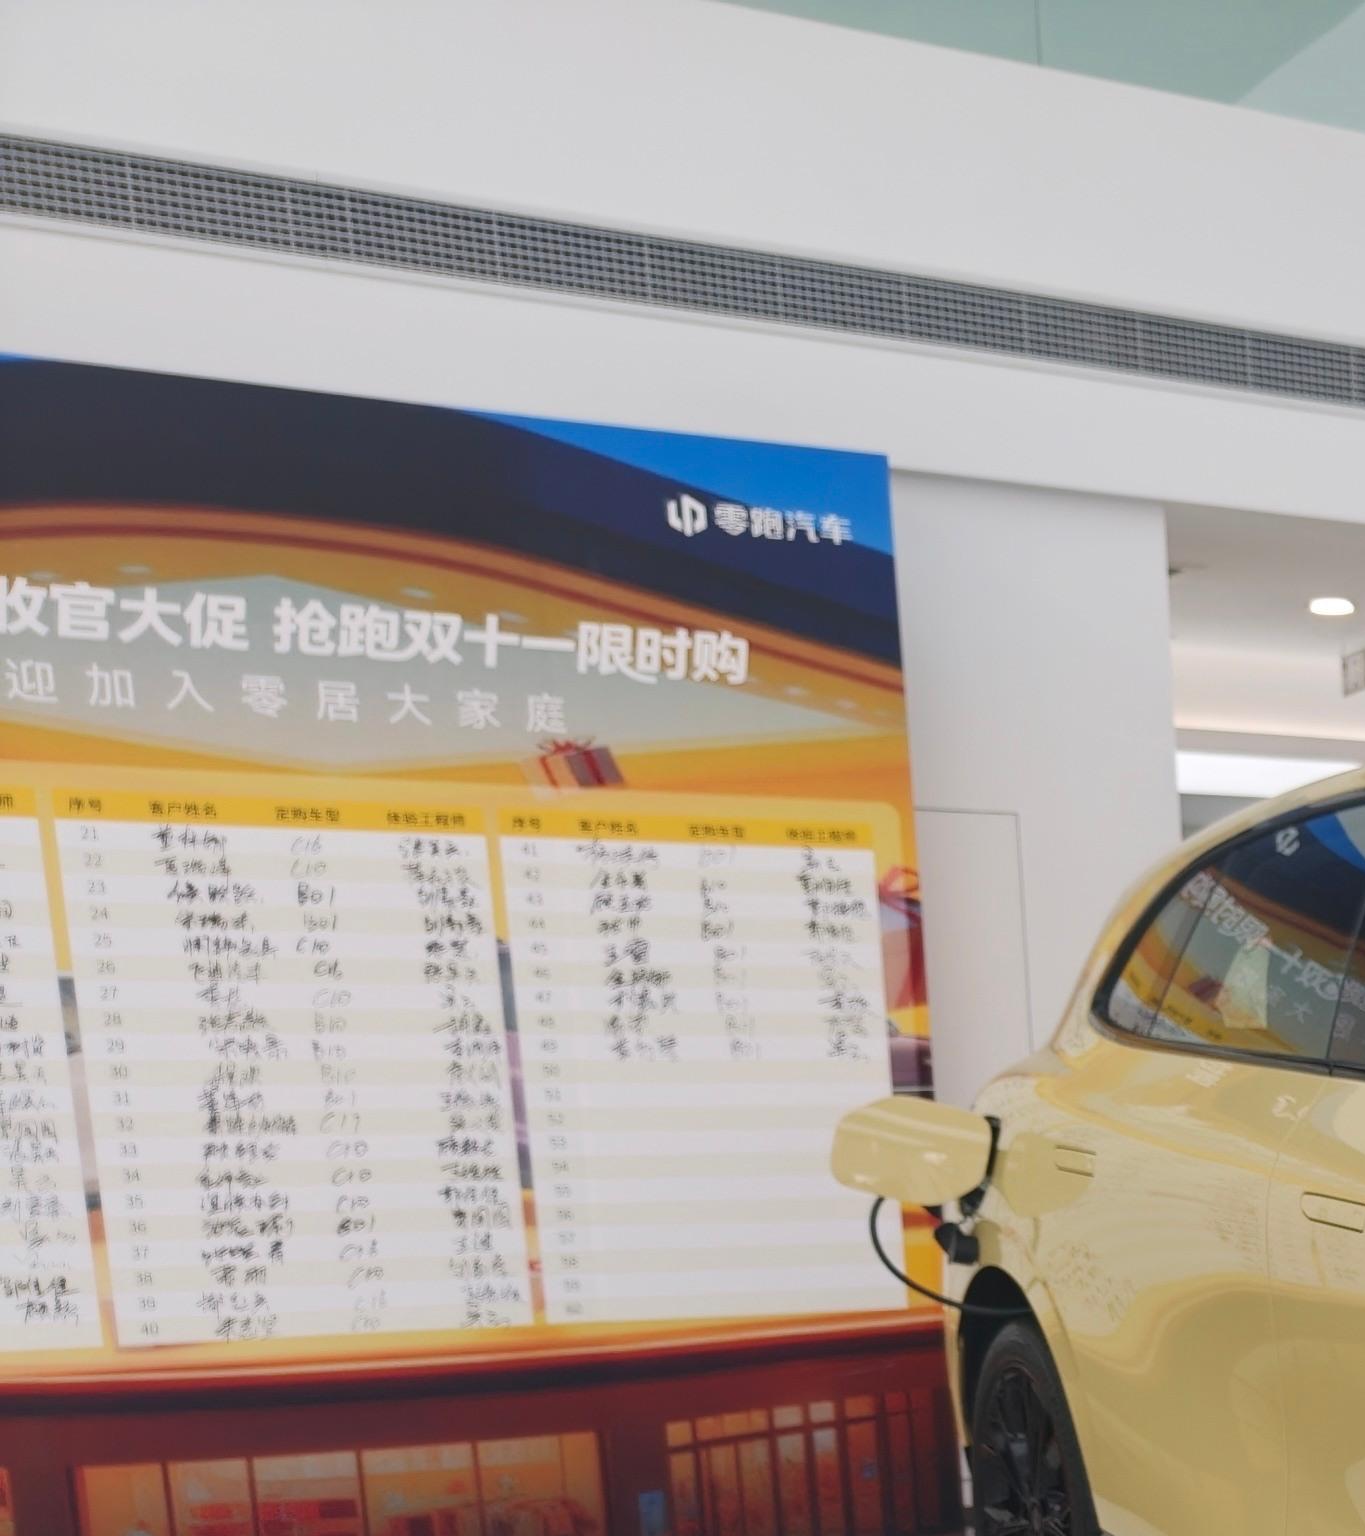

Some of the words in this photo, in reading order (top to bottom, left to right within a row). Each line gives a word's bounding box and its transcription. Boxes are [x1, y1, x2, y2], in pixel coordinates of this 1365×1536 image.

[714, 502, 852, 545] 零跑汽车
[0, 576, 250, 651] 收官大促
[273, 597, 750, 685] 抢跑双十一限时购
[3, 658, 567, 734] 迎加入零居大家庭
